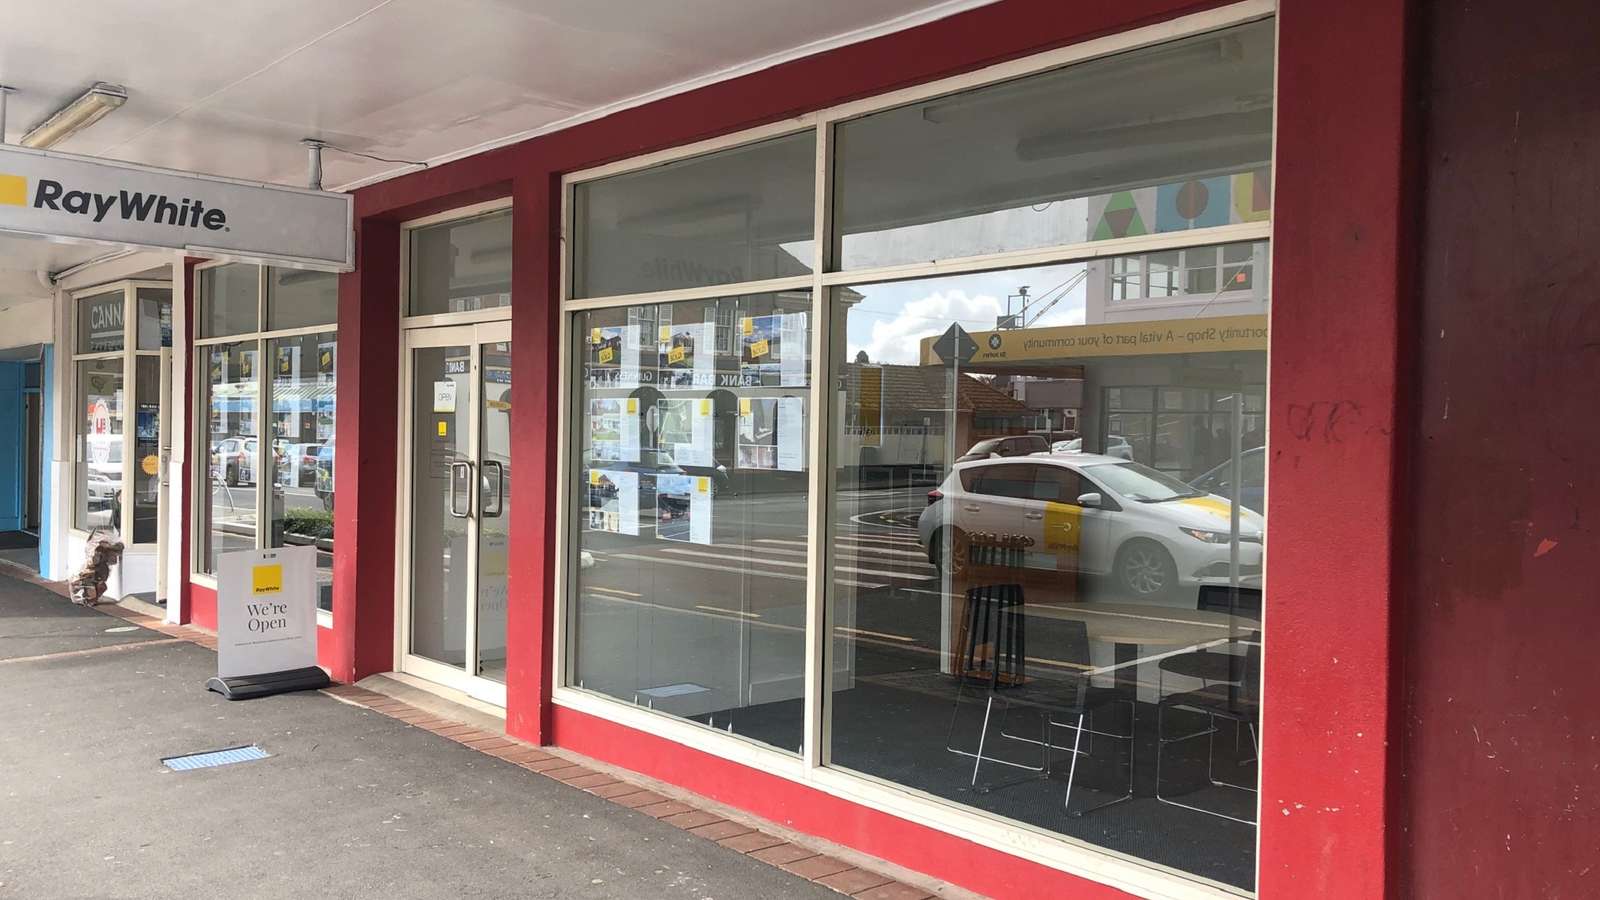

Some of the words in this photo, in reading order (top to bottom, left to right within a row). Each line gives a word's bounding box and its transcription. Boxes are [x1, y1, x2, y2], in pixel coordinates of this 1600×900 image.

[91, 301, 124, 329] CANN
[247, 602, 288, 616] We're
[248, 617, 287, 633] Open
